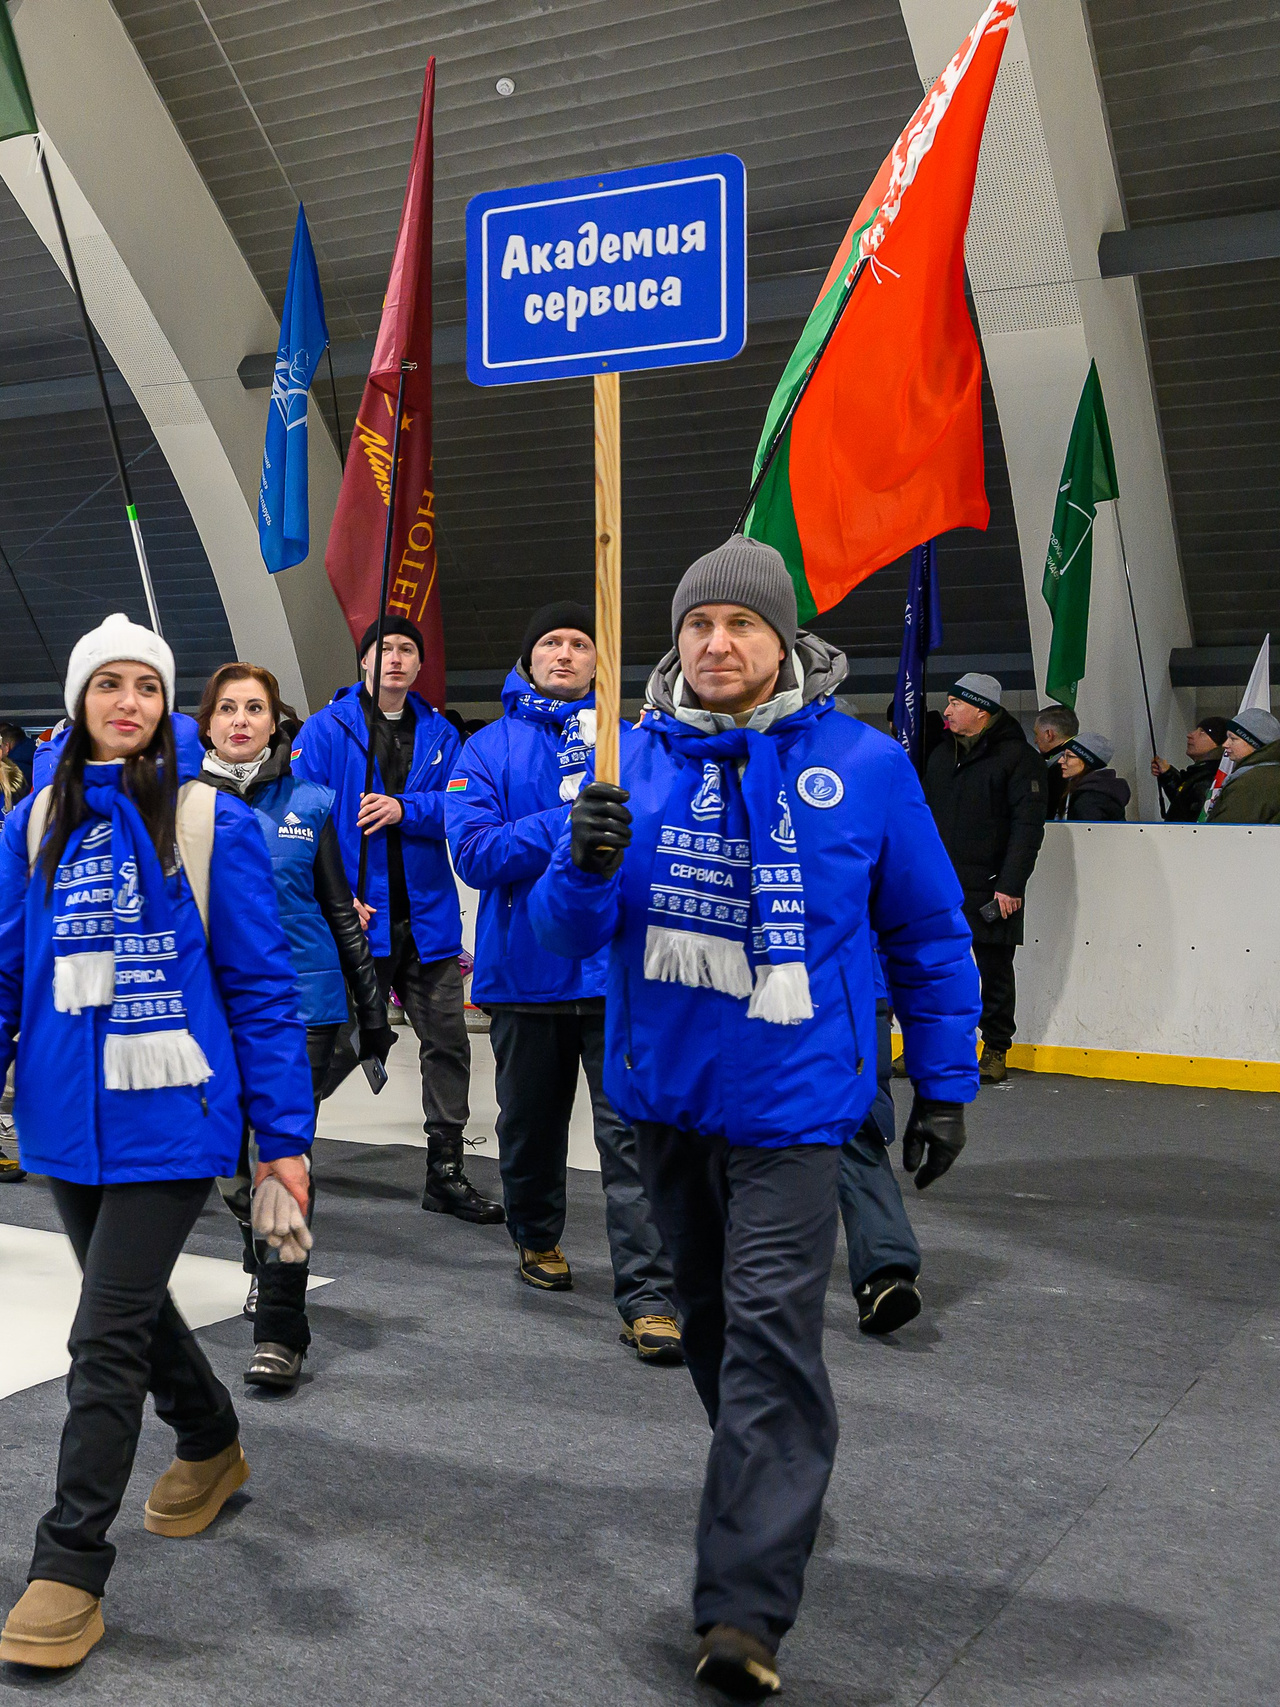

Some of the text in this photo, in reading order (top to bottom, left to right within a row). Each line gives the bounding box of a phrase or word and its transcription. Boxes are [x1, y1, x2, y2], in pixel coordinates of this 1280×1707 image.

[501, 220, 706, 280] Академия
[524, 276, 682, 332] сервиса
[670, 862, 734, 888] СЕРВИСА
